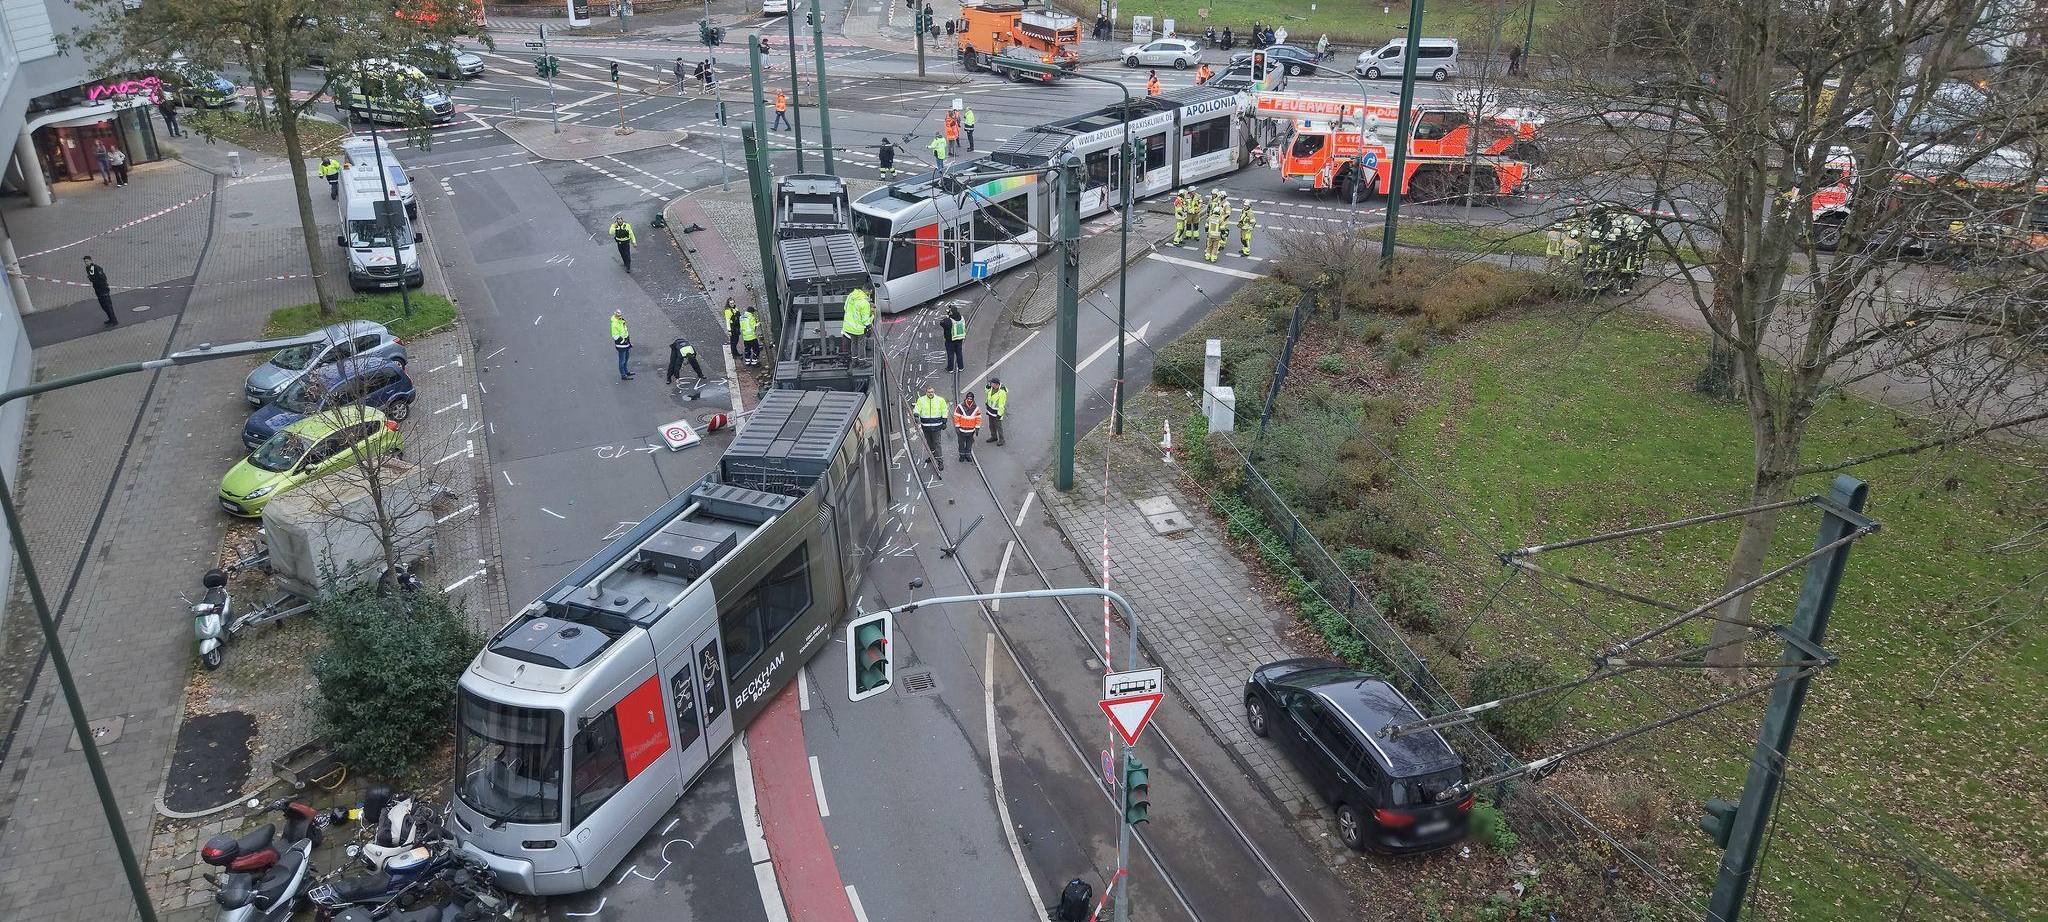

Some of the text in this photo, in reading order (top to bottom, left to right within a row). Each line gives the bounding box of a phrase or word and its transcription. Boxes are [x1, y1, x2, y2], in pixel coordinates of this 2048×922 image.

[1185, 96, 1237, 118] APOLLONIA
[1274, 98, 1351, 116] FEUERWEHR
[670, 429, 683, 440] 30
[593, 445, 630, 459] 12
[735, 651, 785, 709] BECKHAM
[752, 678, 771, 702] BOSS
